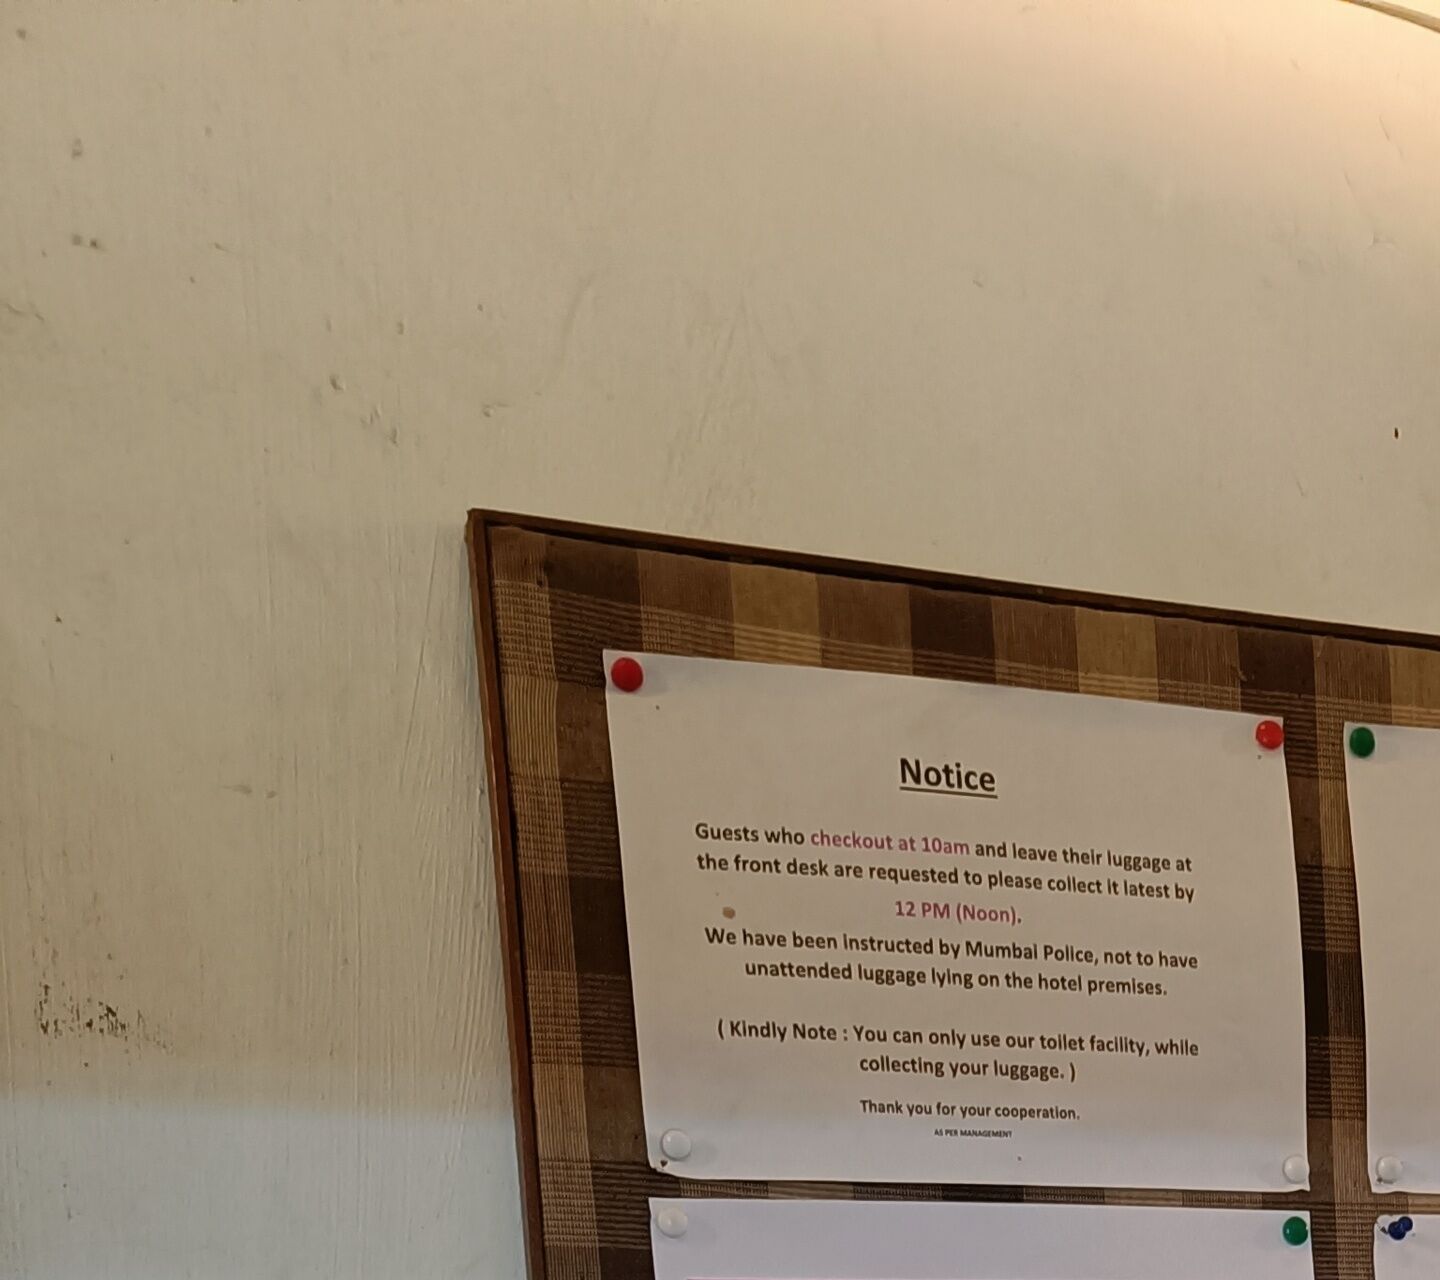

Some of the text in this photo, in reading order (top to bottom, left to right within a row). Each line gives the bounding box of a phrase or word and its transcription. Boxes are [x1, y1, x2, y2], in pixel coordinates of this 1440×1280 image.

[899, 756, 995, 792] Notice
[694, 821, 1192, 873] Guests who checkout at 10am and leave their luggage at
[894, 899, 1022, 926] 12 PM (Noon).
[744, 961, 1167, 996] unattended luggage lying on the hotel premises.
[858, 1098, 1080, 1121] Thank you for your cooperation.
